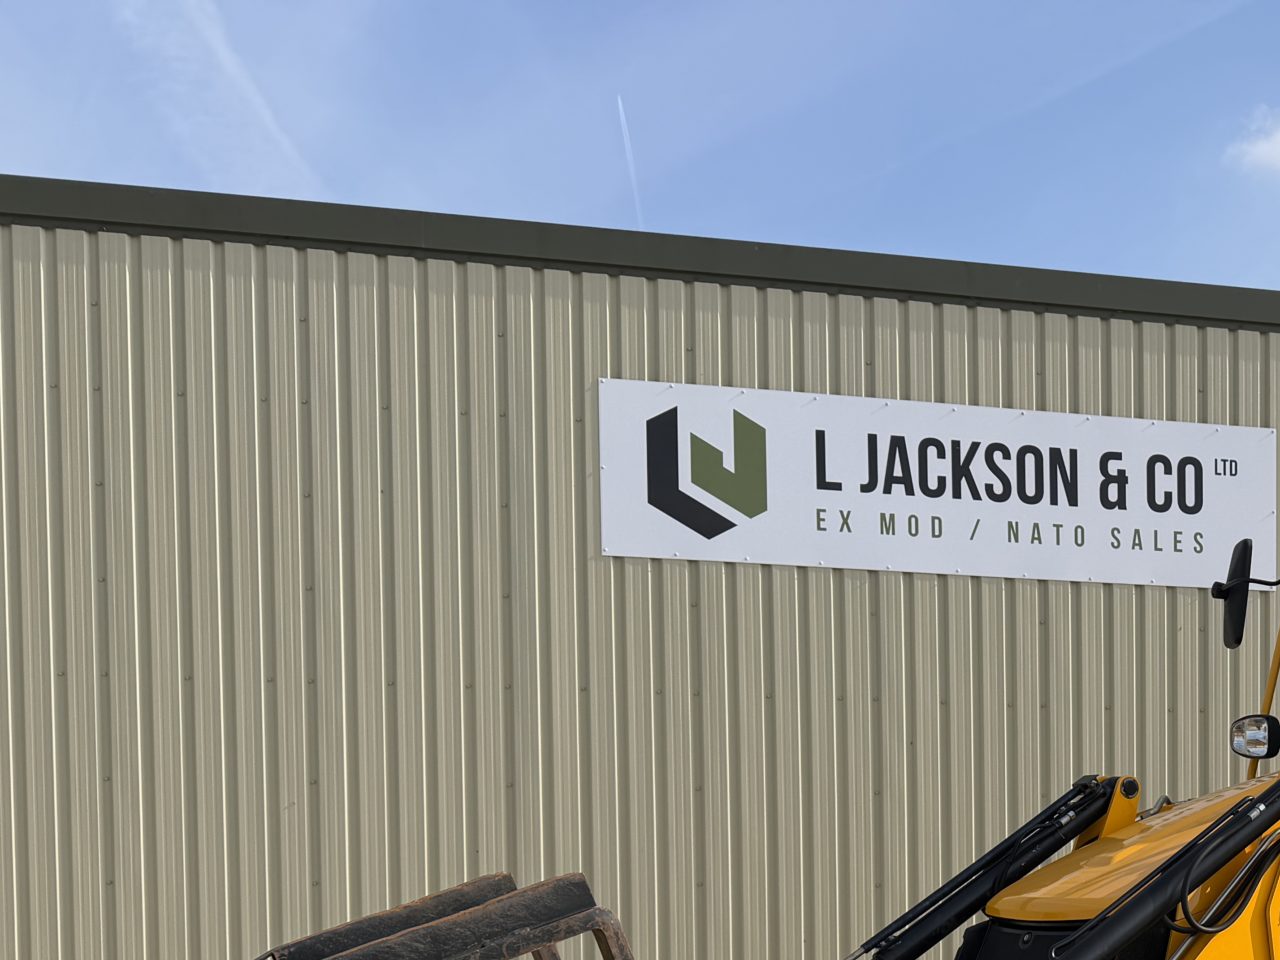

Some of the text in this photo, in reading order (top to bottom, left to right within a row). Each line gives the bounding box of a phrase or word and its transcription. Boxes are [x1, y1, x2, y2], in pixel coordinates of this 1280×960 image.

[815, 429, 1238, 514] L JACKSON & CO LTD
[816, 508, 1204, 554] EX MOD / NATO SALES
